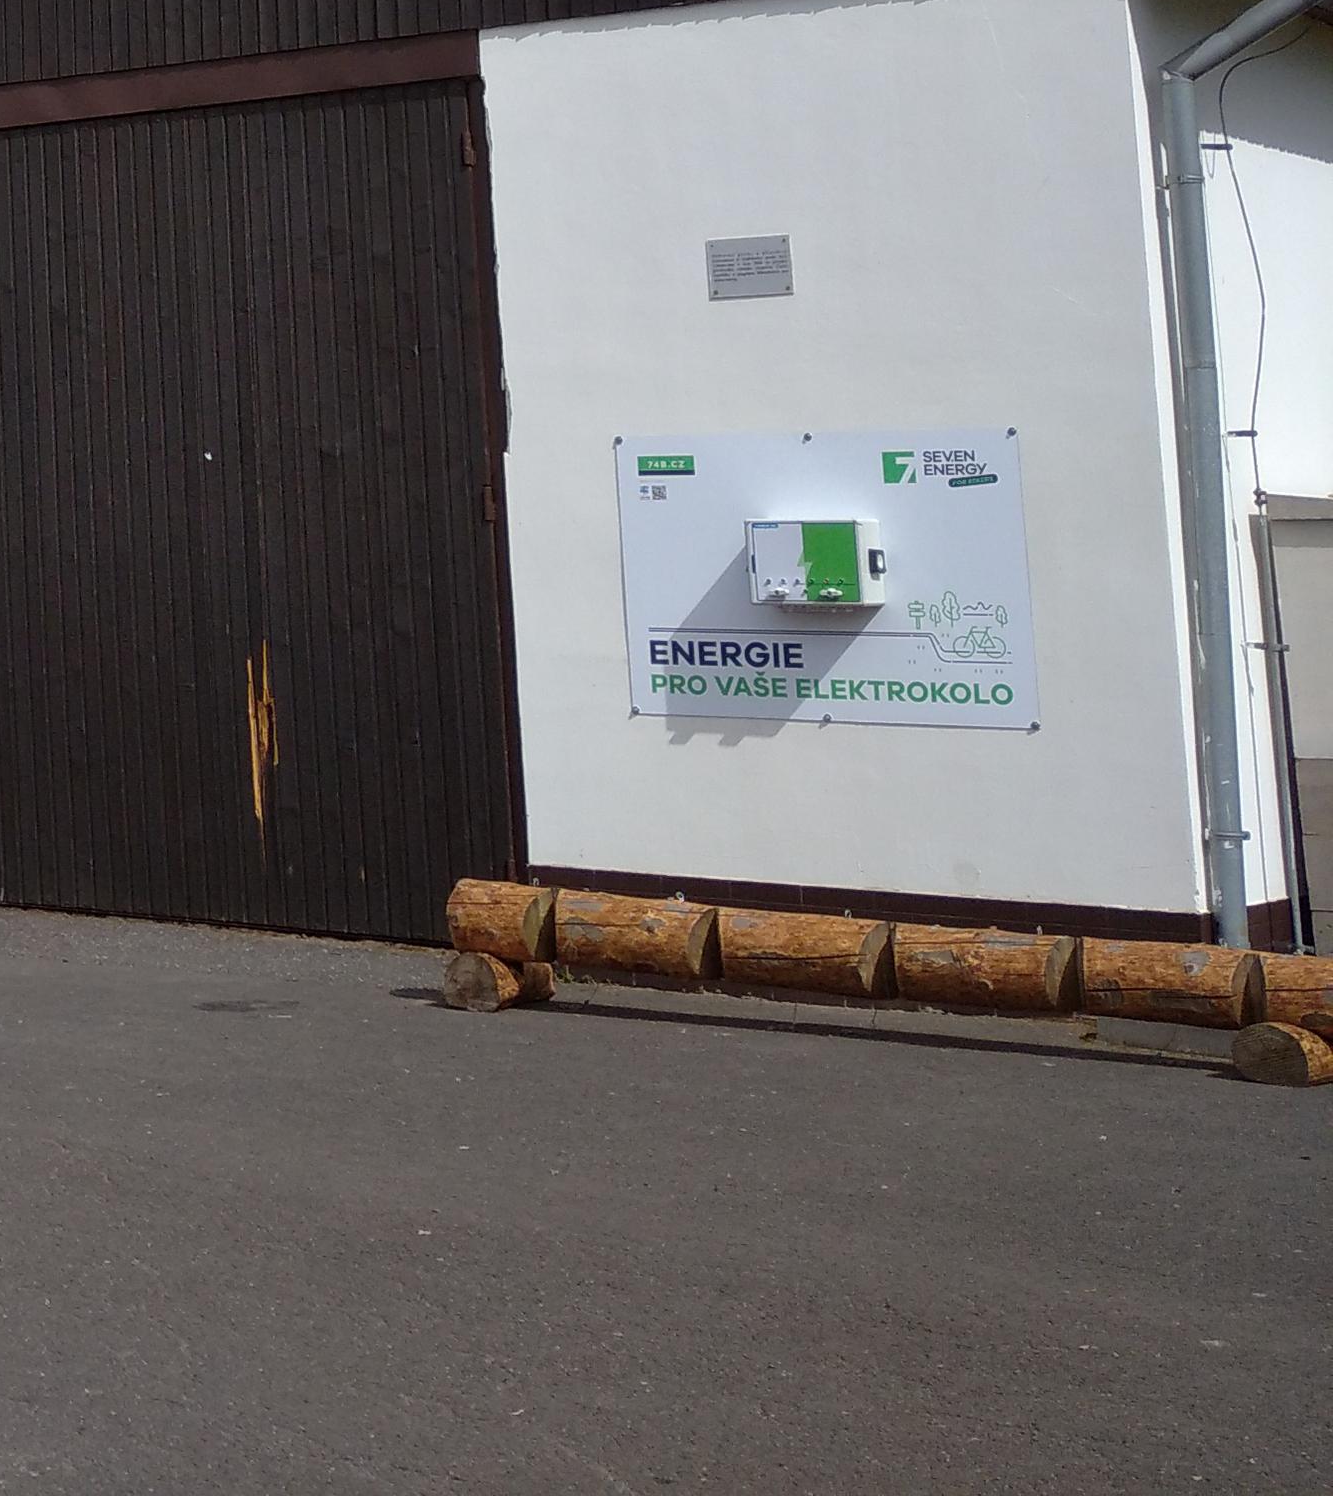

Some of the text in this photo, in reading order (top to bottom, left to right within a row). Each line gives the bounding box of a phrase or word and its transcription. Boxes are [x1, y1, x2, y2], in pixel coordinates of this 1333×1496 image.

[923, 463, 988, 476] ENERGY
[648, 639, 805, 669] ENERGIE
[651, 671, 1014, 706] PRO VAŠE ELEKTROKOLO
